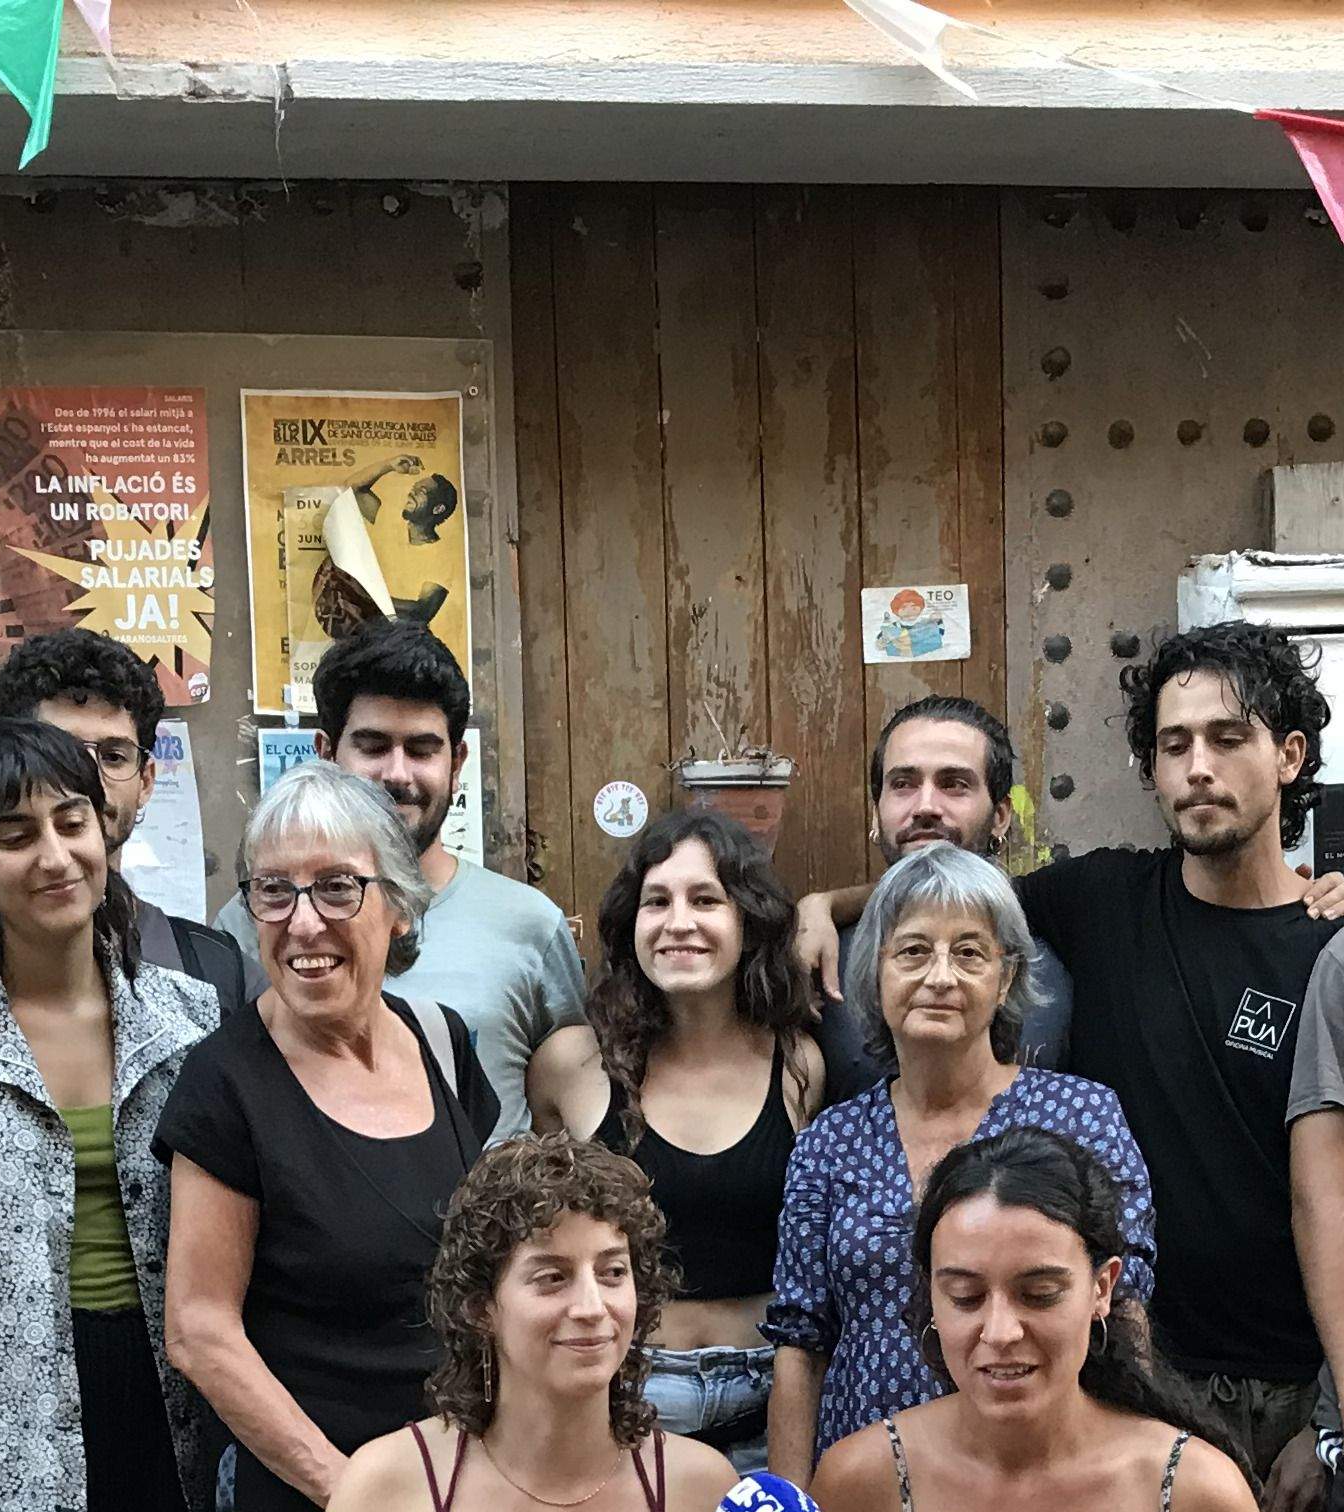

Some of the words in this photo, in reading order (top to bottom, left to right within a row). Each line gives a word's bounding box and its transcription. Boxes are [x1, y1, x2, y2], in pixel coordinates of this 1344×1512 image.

[55, 408, 74, 418] Des
[77, 408, 89, 418] de
[118, 408, 128, 418] el
[130, 408, 156, 418] salari
[188, 410, 194, 418] a
[76, 423, 121, 435] espanyol
[301, 419, 328, 446] IX
[328, 429, 338, 438] DE
[341, 430, 362, 439] SANT
[49, 439, 87, 448] mentre
[89, 440, 109, 450] que
[110, 439, 121, 448] el
[123, 439, 145, 448] cost
[147, 438, 161, 448] de
[162, 438, 172, 448] la
[173, 438, 195, 448] vida
[86, 454, 99, 463] ha
[101, 454, 156, 465] augmentat
[158, 455, 171, 463] un
[275, 448, 357, 467] ARRELS
[35, 475, 63, 494] LA
[68, 471, 166, 494] INFLACIÓ
[172, 471, 196, 494] ÉS
[50, 503, 79, 521] UN
[86, 503, 197, 521] ROBATORI.
[297, 500, 322, 510] DIV
[90, 539, 202, 562] PUJADES
[80, 567, 215, 589] SALARIALS
[927, 591, 954, 601] TEO
[114, 594, 181, 631] JA!
[266, 745, 281, 755] EL
[1242, 994, 1271, 1020] LA
[1234, 1015, 1276, 1045] PUA
